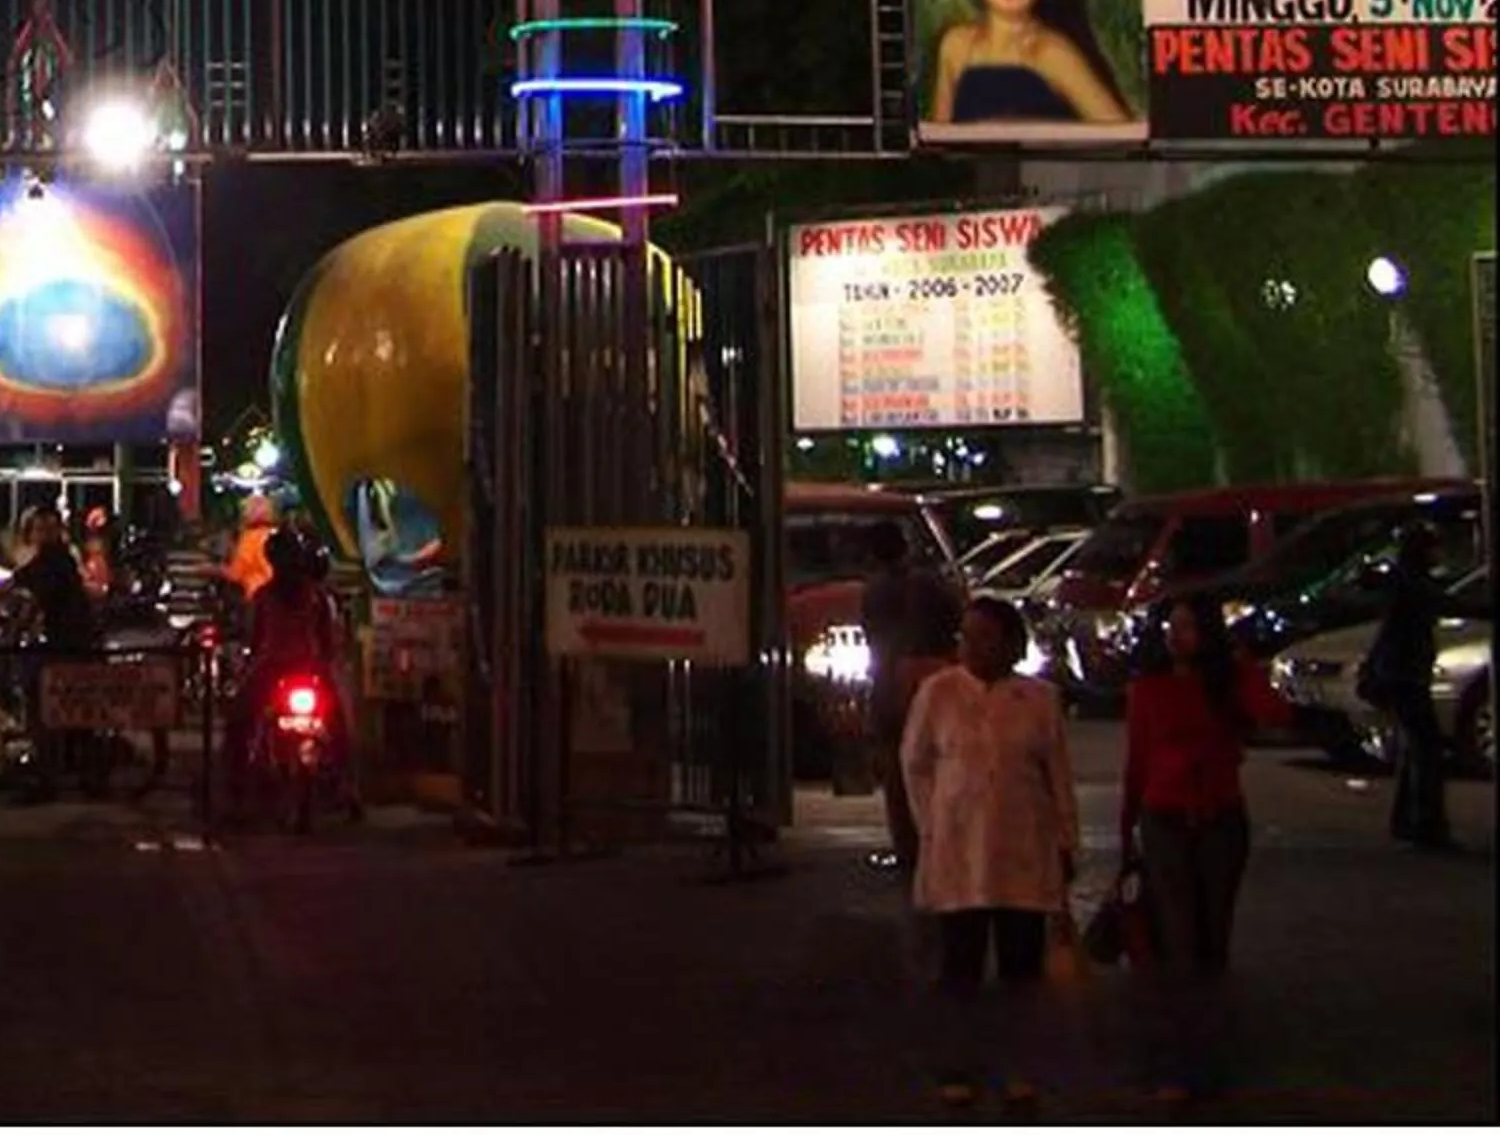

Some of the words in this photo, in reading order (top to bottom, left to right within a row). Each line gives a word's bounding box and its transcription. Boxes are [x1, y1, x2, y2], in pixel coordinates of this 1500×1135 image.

[1154, 28, 1312, 74] PENTAS
[1331, 27, 1429, 73] SENI
[1444, 27, 1497, 71] SI
[1322, 102, 1497, 137] GENTEN
[801, 225, 884, 257] PENTAS
[896, 219, 948, 252] SENI
